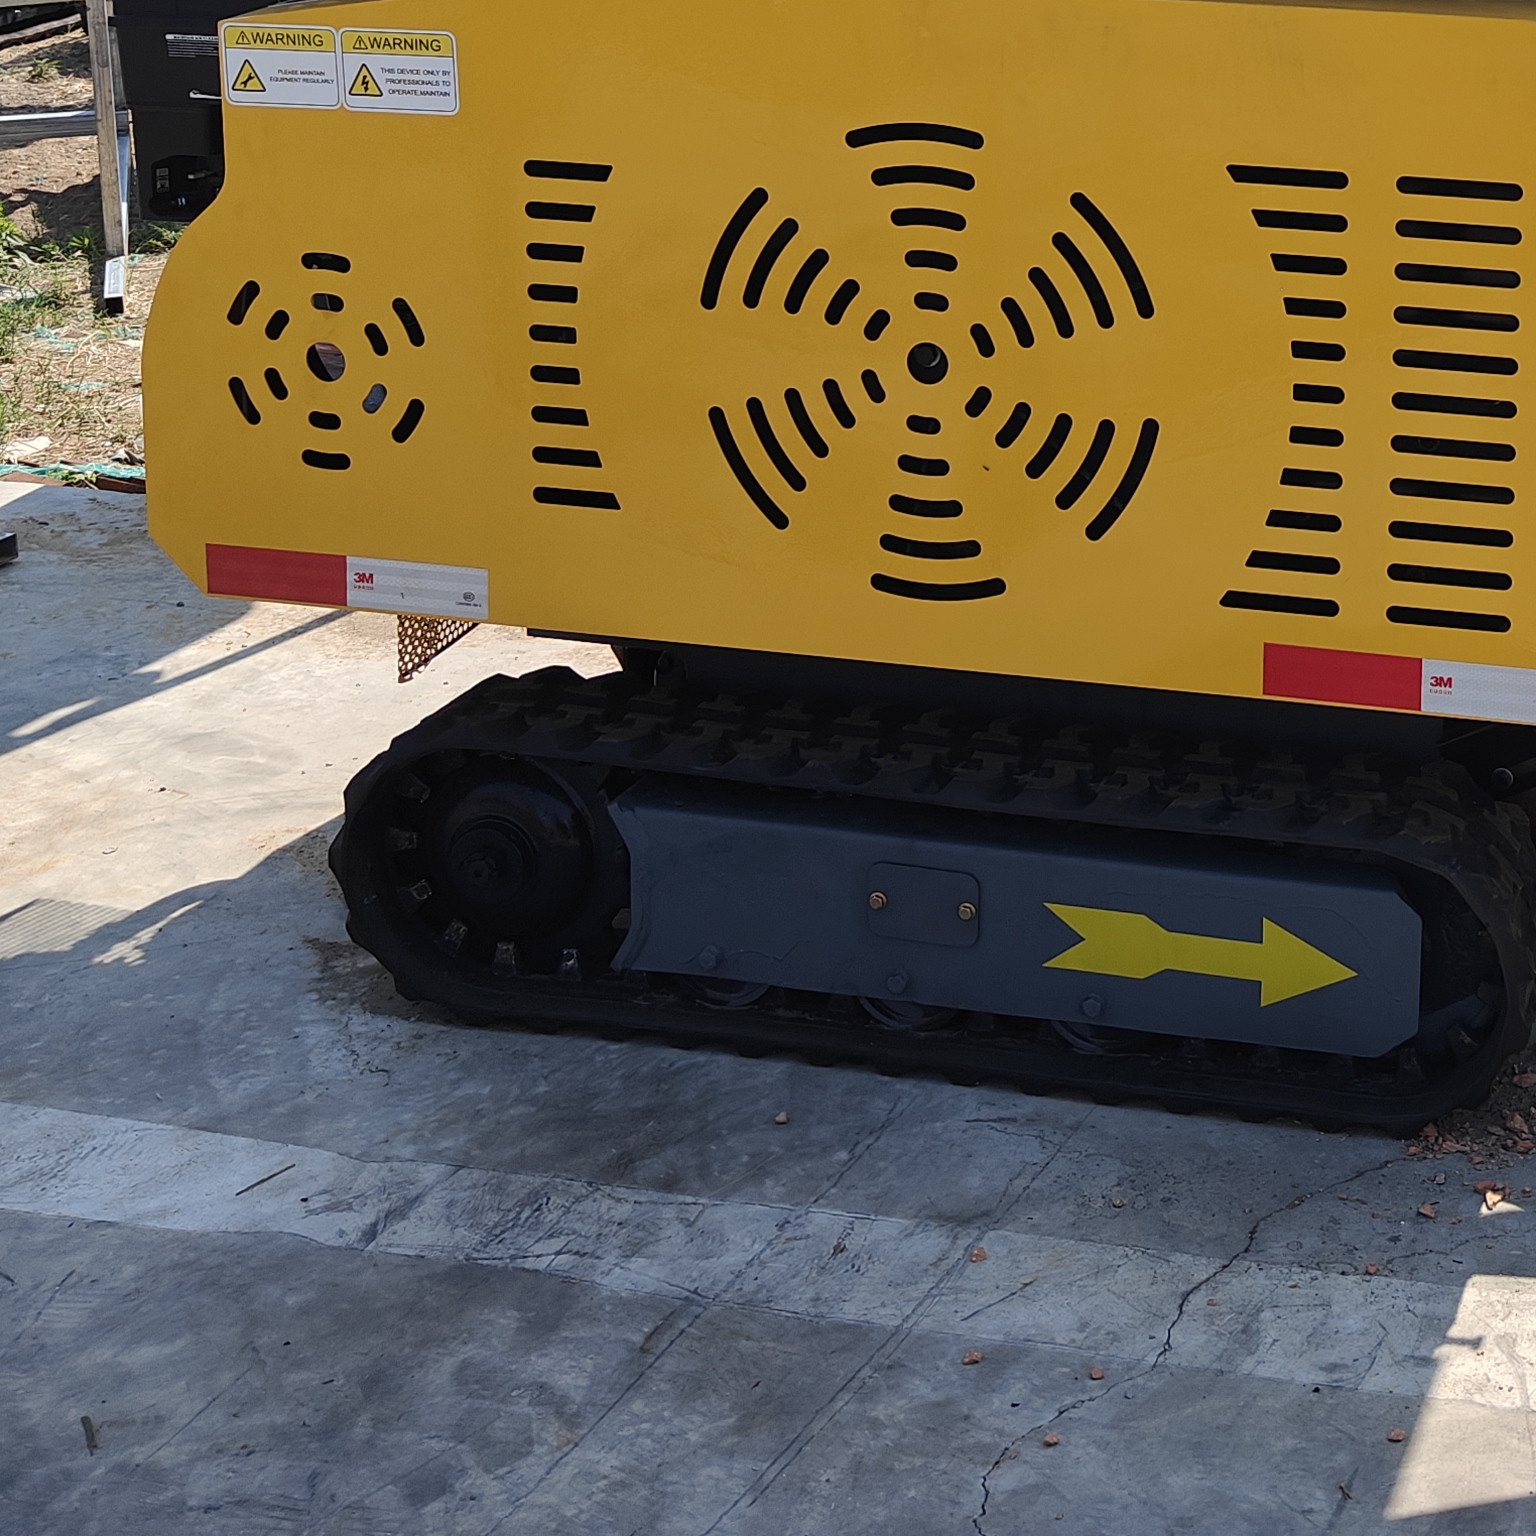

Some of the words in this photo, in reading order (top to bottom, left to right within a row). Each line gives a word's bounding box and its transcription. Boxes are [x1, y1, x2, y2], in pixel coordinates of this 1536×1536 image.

[251, 31, 324, 47] WARNING
[368, 36, 442, 52] WARNING
[385, 78, 440, 86] PROFESSIONALS
[353, 572, 374, 584] 3M
[1429, 676, 1453, 689] 3M
